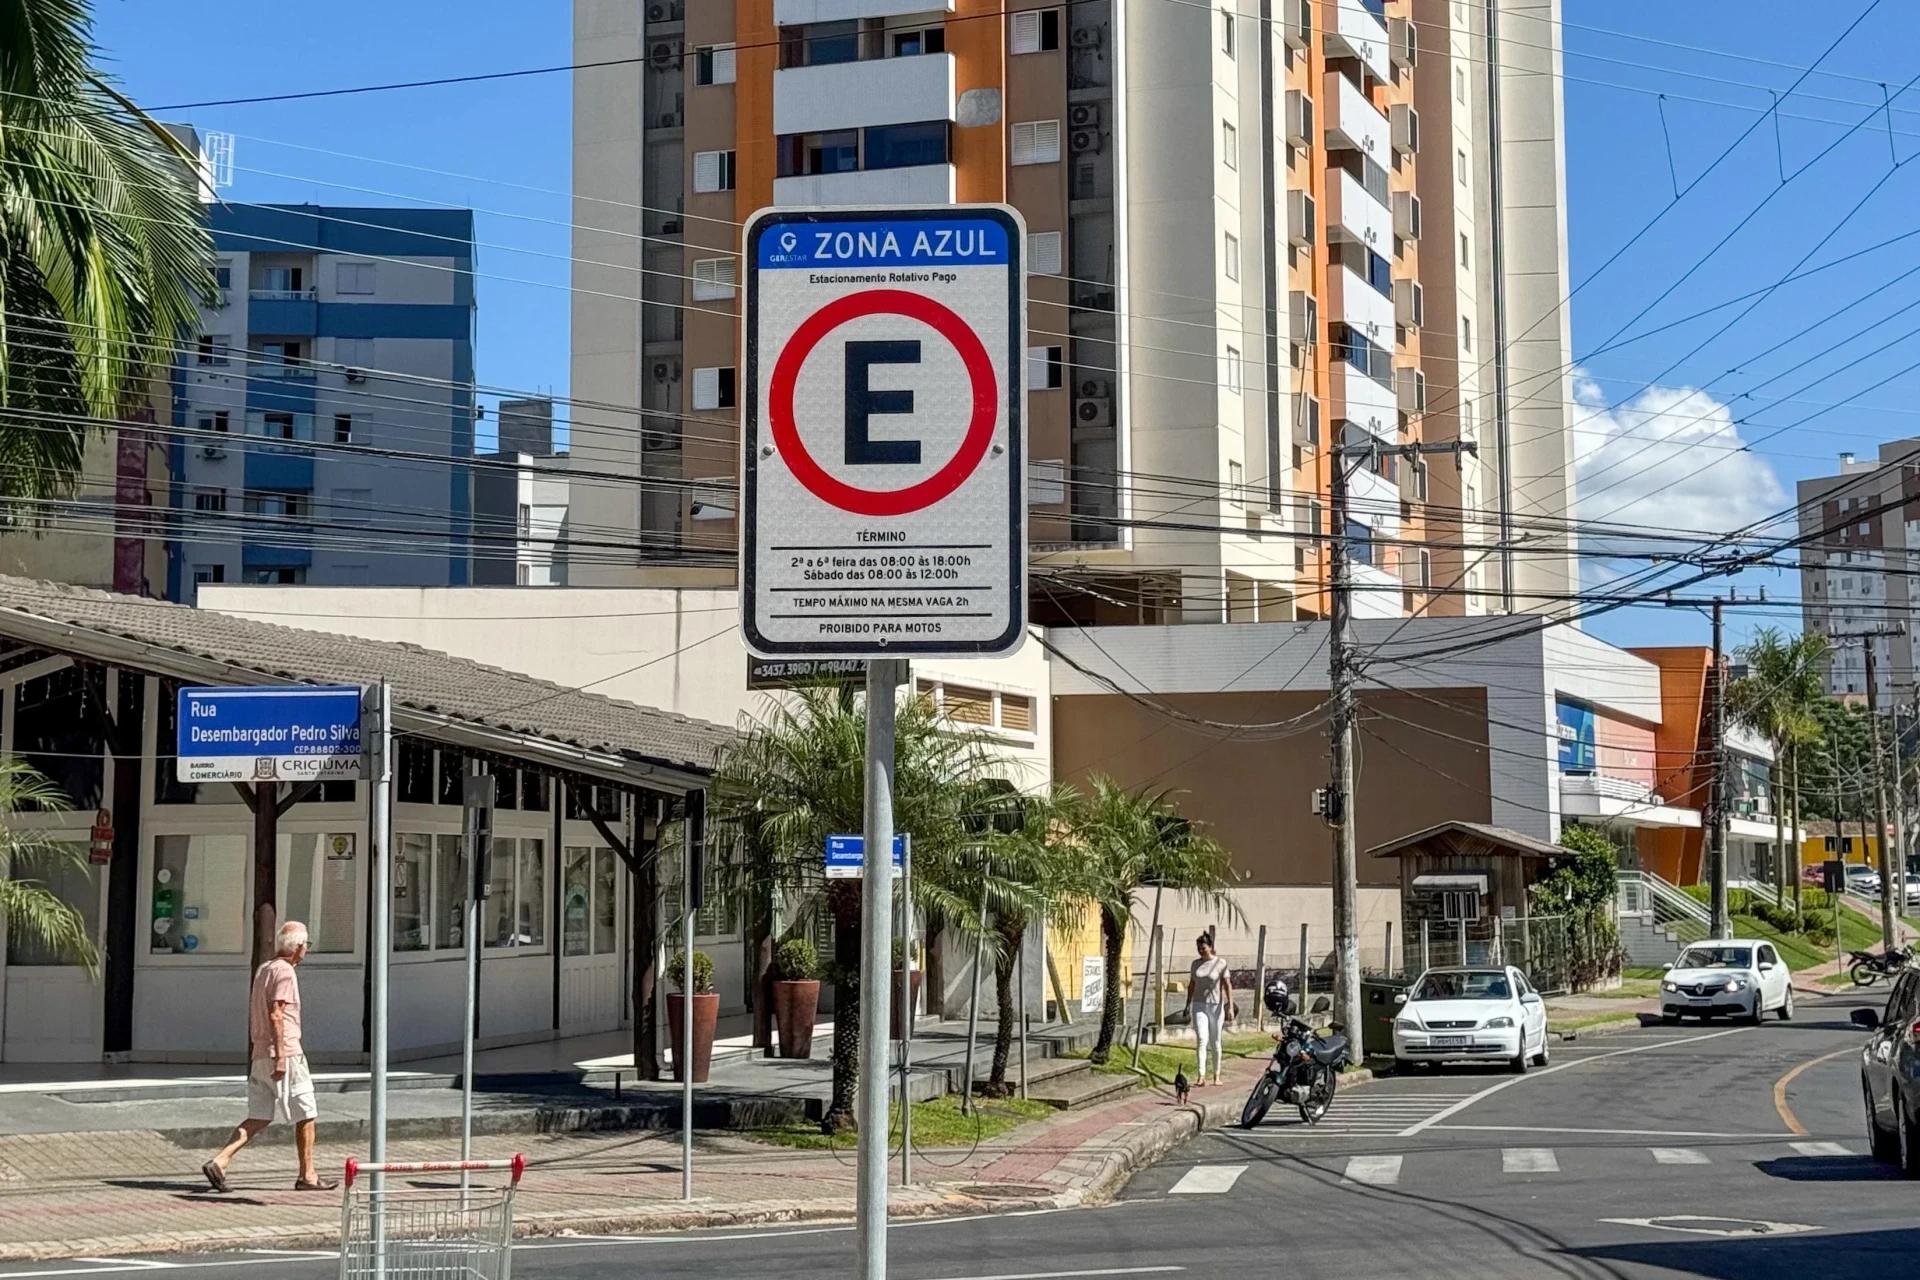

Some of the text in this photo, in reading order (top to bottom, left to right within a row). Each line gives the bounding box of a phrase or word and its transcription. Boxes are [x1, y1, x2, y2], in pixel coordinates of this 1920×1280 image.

[814, 229, 996, 259] ZONA AZUL
[809, 272, 957, 284] Estacionamento Rotativo Pago
[845, 340, 921, 464] E
[856, 529, 906, 542] TÉRMINO
[832, 556, 856, 567] feira
[859, 556, 878, 567] das
[880, 556, 915, 567] 08:00
[918, 555, 930, 567] às
[933, 555, 971, 566] 18:00h
[803, 568, 959, 580] Sábado das 08:00 às 12:00h
[793, 595, 969, 608] TEMPO MÁXIMO NA MESMA VAGA 2h
[819, 622, 942, 634] PROIBIDO PARA MOTOS
[191, 701, 217, 718] Rua
[191, 724, 360, 747] Desembargador Pedro Silva
[190, 770, 243, 780] COMERCIÁRIO
